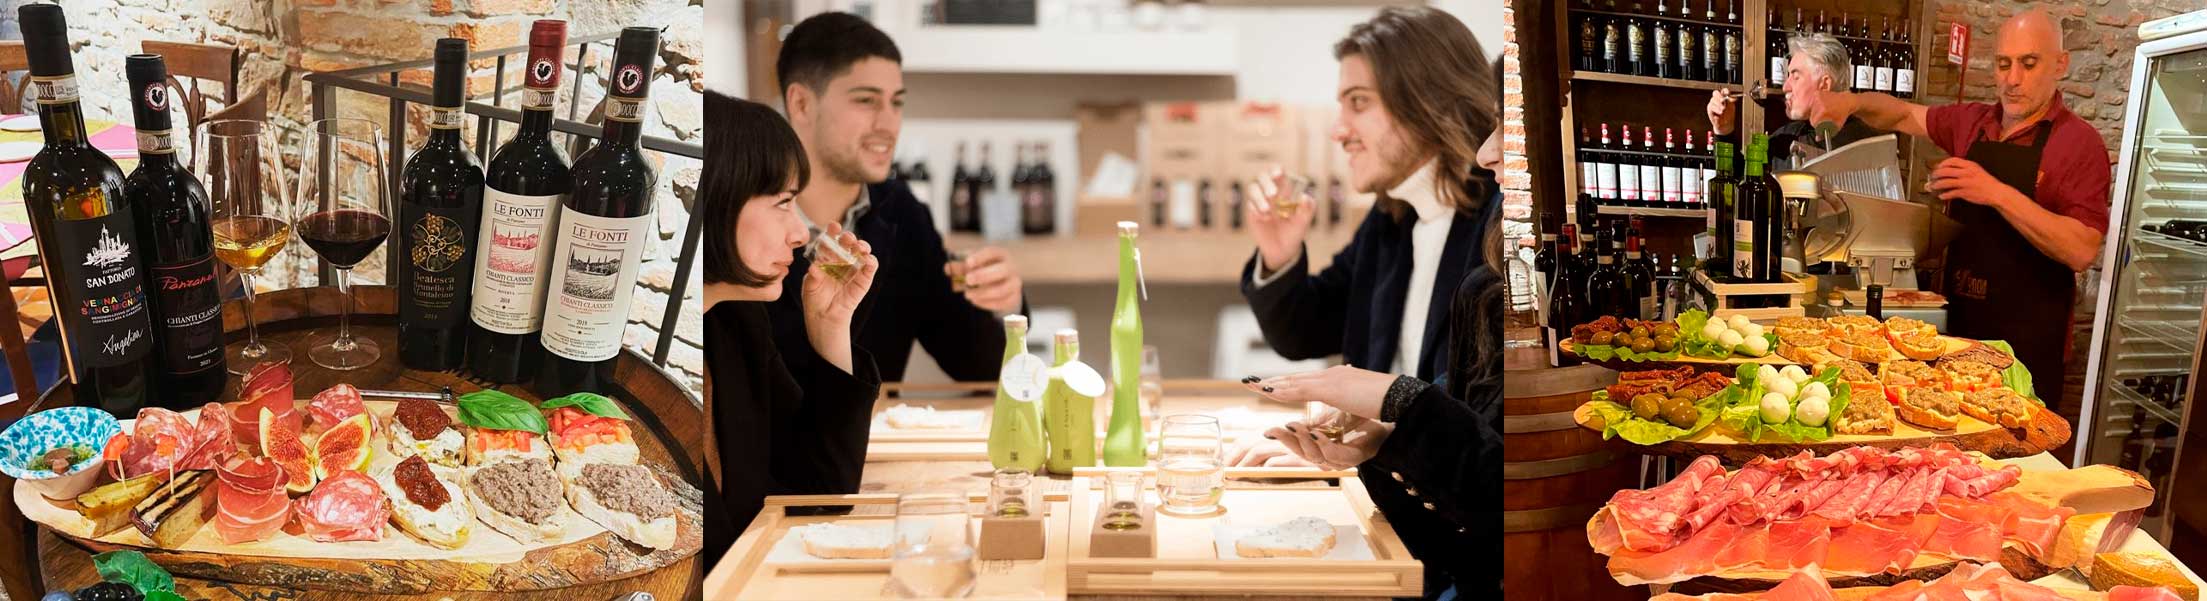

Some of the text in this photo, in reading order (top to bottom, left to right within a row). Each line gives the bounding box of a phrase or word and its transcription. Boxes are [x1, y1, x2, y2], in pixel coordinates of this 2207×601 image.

[494, 202, 544, 217] LE FONTI
[572, 226, 628, 241] LE FONTI
[86, 266, 135, 289] SAN DONATO
[167, 314, 197, 325] CHIANTI
